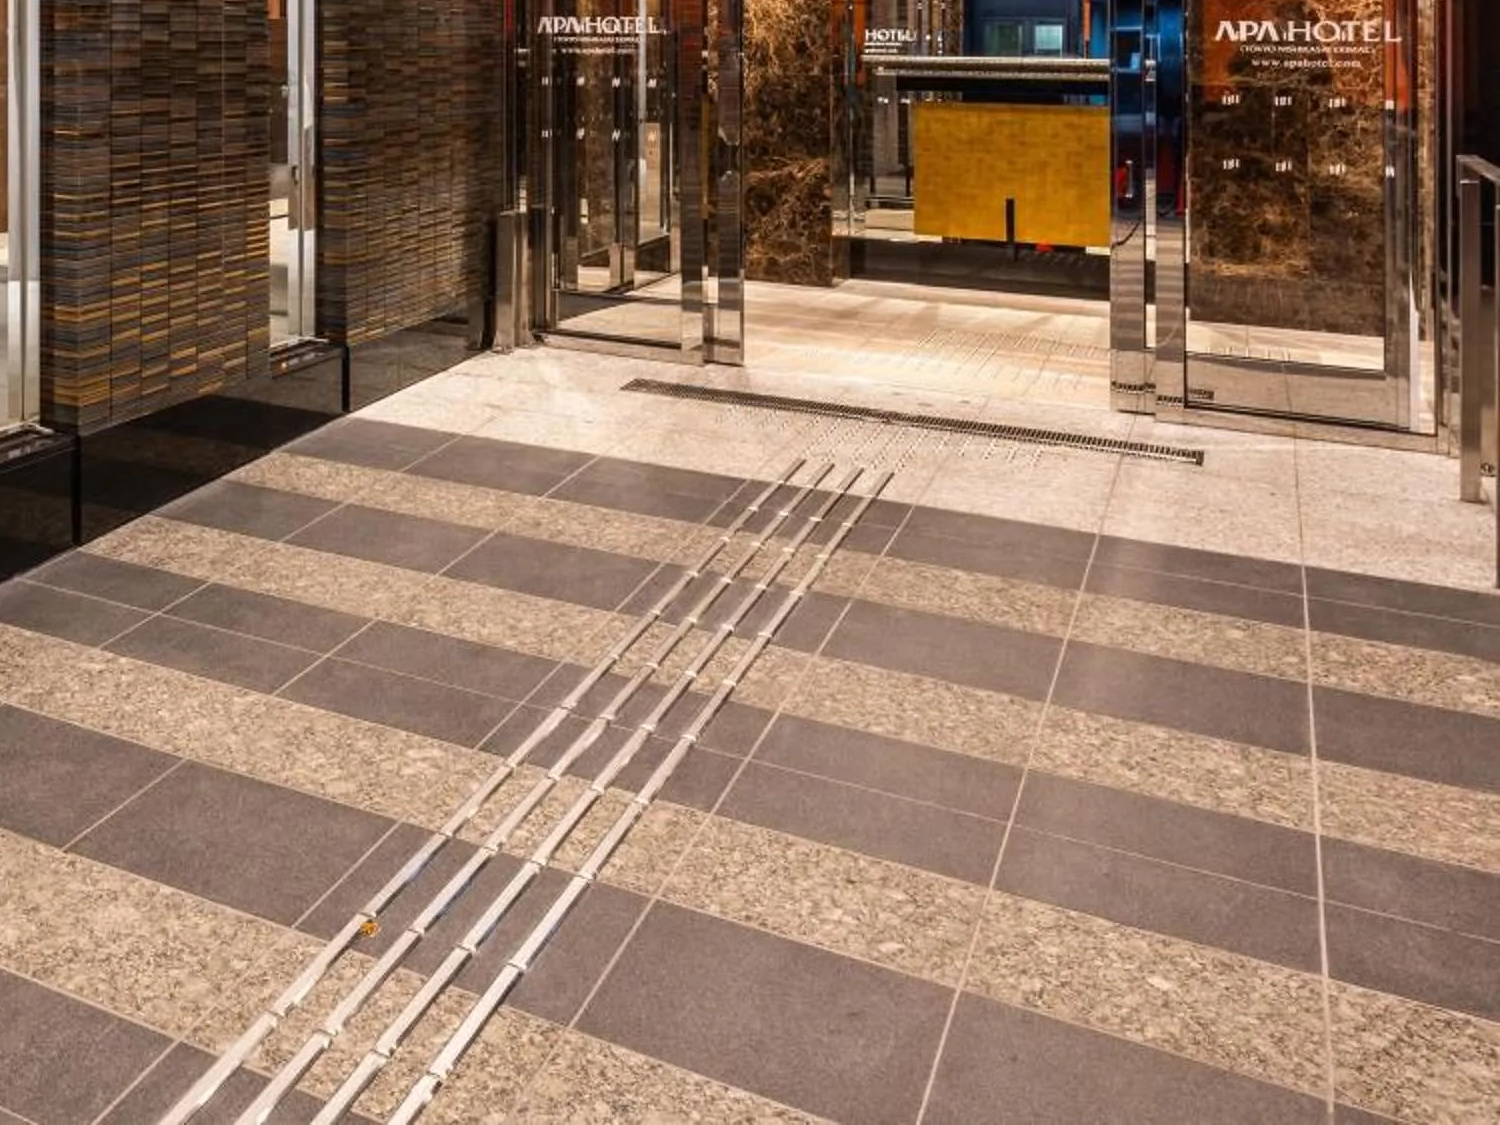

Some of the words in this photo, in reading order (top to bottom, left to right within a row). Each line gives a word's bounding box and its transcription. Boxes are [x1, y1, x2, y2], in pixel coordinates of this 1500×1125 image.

[537, 16, 581, 34] APA
[585, 16, 661, 34] HOTEL
[1214, 20, 1280, 42] APA
[1288, 20, 1402, 42] HOTEL
